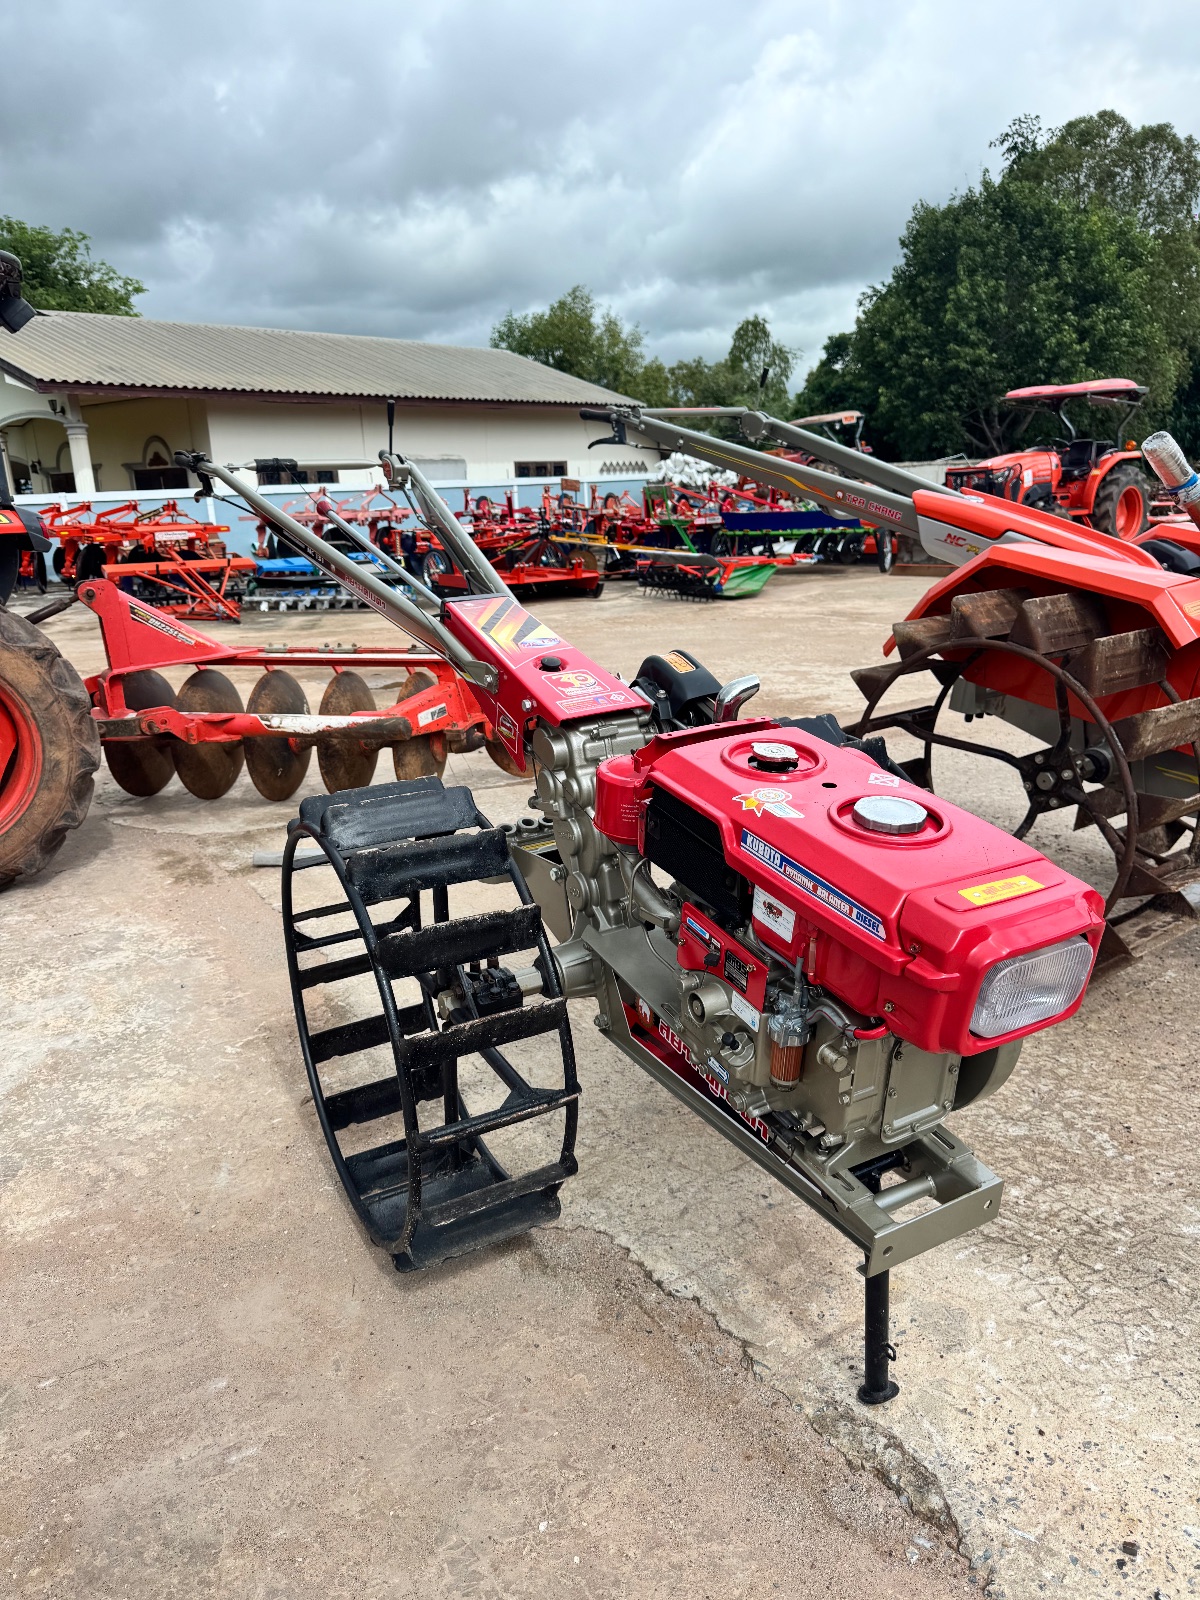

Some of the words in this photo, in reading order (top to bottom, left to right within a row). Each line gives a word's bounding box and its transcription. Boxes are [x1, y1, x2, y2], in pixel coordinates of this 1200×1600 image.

[846, 492, 866, 508] TRA
[867, 501, 903, 521] CHANG
[944, 533, 967, 547] NC
[746, 832, 782, 867] KUBOTA
[816, 885, 850, 914] BALANCER
[855, 911, 880, 934] DIESEL
